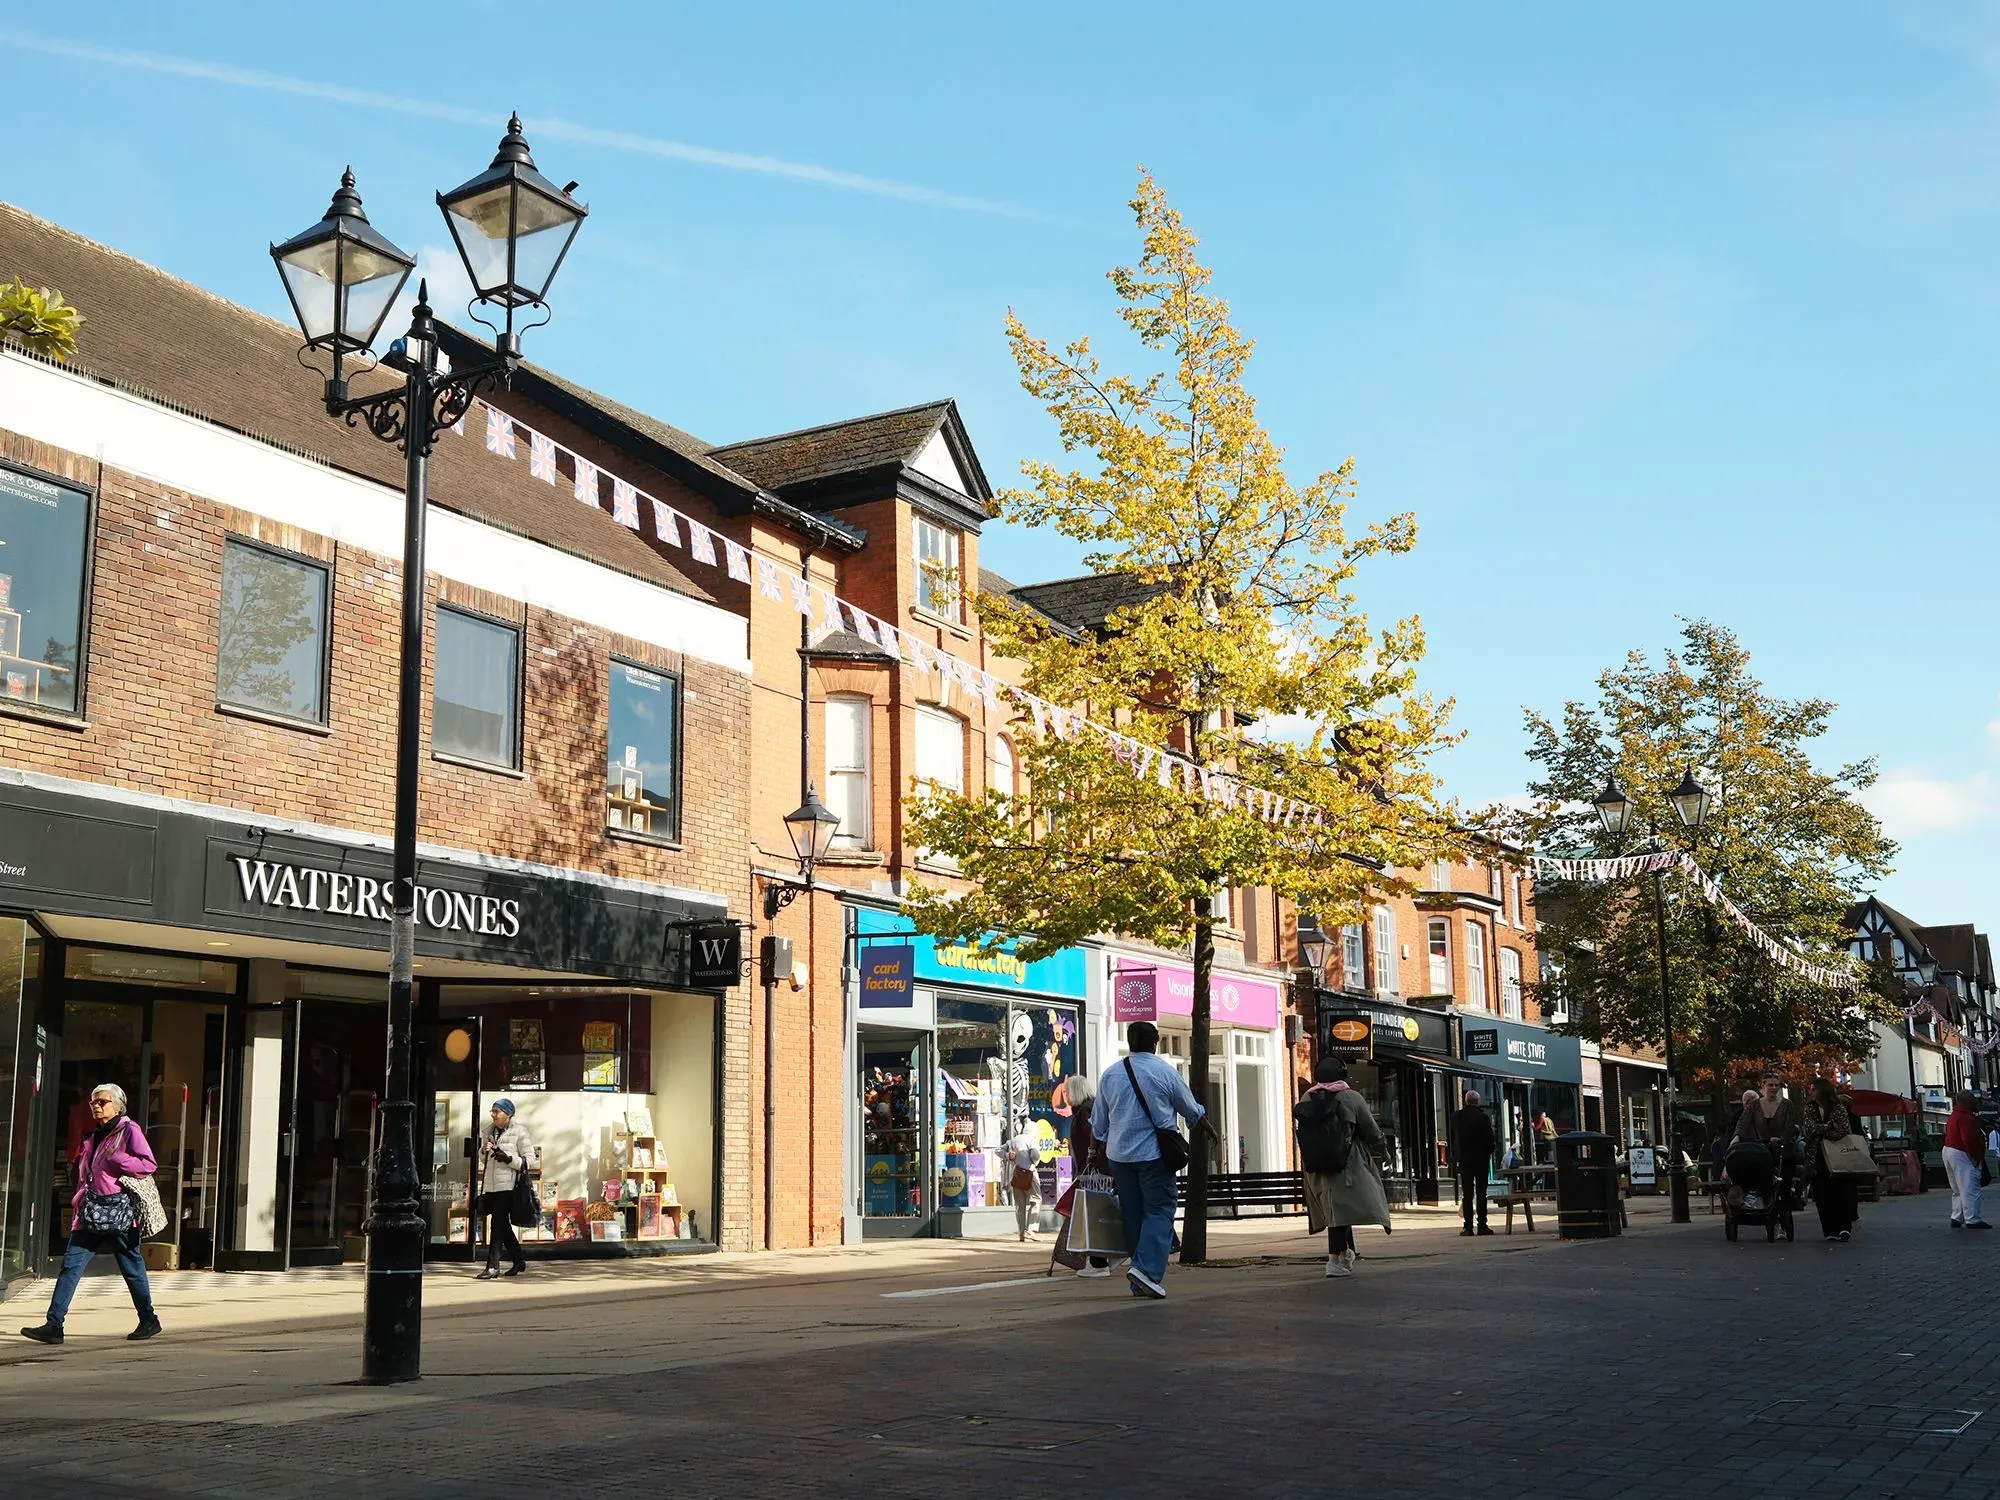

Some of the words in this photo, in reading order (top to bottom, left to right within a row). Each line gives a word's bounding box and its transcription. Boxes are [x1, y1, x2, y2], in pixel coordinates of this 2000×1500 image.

[0, 469, 16, 484] lick
[17, 476, 25, 486] &
[26, 478, 59, 496] Collect
[0, 485, 57, 508] aterstones.com
[0, 860, 27, 876] Street
[235, 857, 520, 938] WATERSTONES
[699, 938, 730, 967] W
[695, 969, 733, 977] WATERSTONES
[873, 960, 900, 975] card
[865, 976, 907, 992] factory
[1507, 1038, 1526, 1057] WHITE
[1527, 1041, 1546, 1060] STUFF
